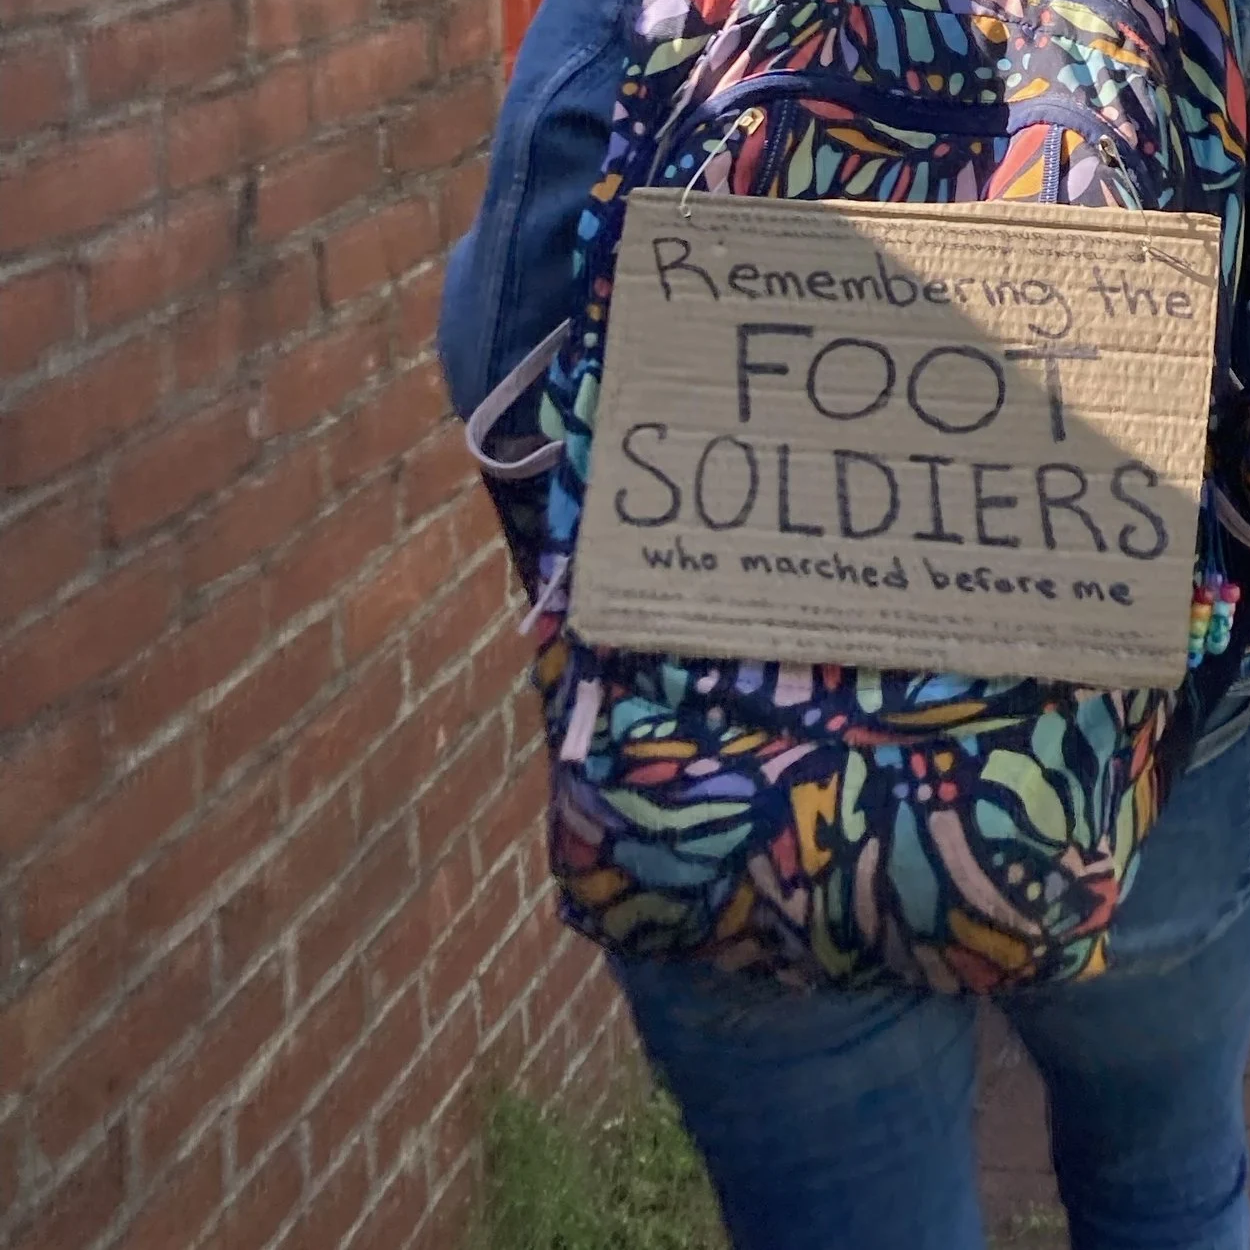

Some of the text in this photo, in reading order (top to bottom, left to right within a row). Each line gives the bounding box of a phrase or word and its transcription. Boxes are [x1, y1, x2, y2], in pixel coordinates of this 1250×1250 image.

[652, 235, 1194, 340] Remembering the
[735, 322, 1100, 443] FOOT
[614, 422, 1168, 561] SOLDIERS
[641, 536, 1135, 608] who marched before me
